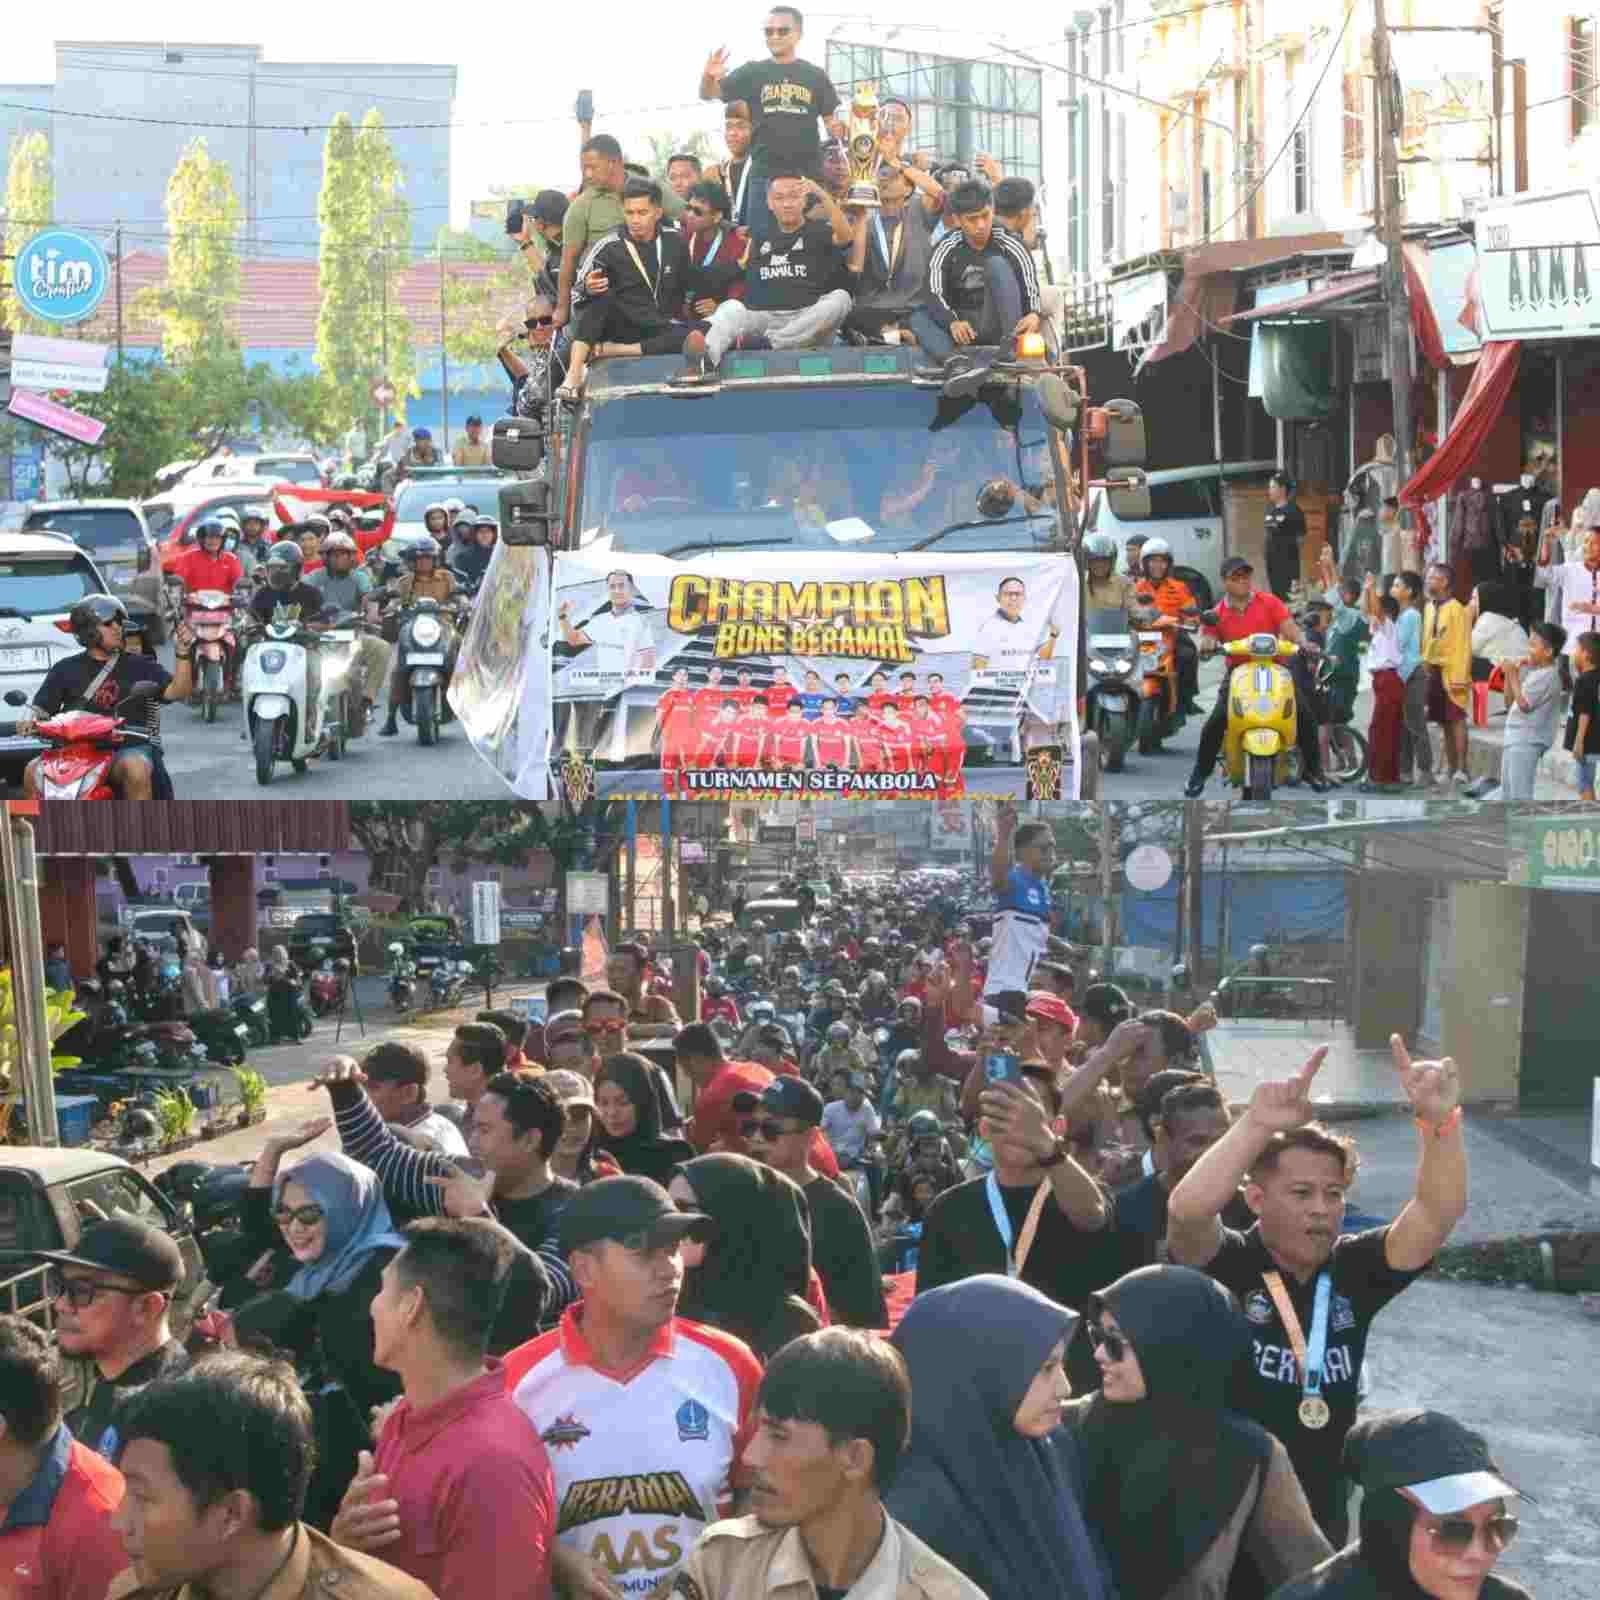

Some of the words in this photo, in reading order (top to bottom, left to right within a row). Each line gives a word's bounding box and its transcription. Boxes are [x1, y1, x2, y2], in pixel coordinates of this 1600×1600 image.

[31, 249, 92, 288] tim
[667, 574, 952, 639] CHAMPION
[713, 622, 786, 660] BONE
[790, 622, 915, 663] BERAMAL
[685, 770, 803, 790] TURNAMEN
[808, 772, 937, 791] SEPAKBOLA
[591, 1523, 684, 1574] AAS
